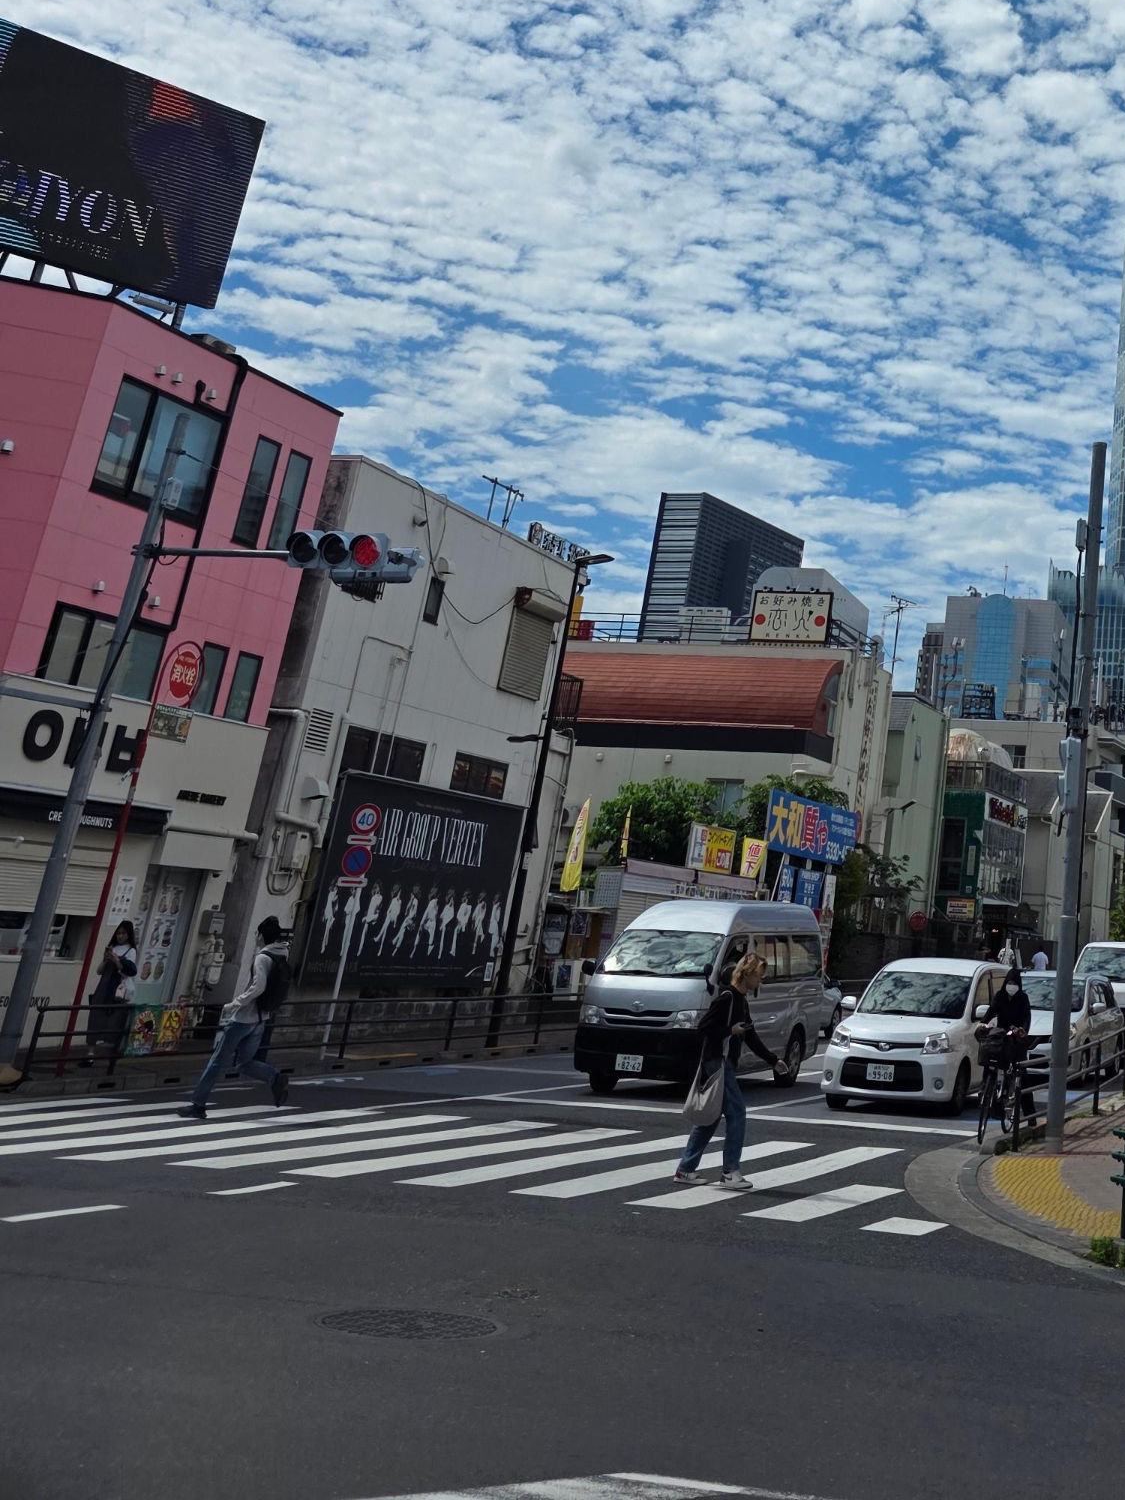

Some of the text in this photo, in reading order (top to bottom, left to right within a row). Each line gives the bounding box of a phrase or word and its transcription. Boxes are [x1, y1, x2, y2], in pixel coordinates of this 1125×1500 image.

[759, 594, 826, 607] お好み焼き
[171, 663, 196, 686] 消火栓
[358, 812, 374, 826] 40
[769, 796, 829, 854] 大和質や
[373, 808, 489, 867] AIR GROUP VERTEX
